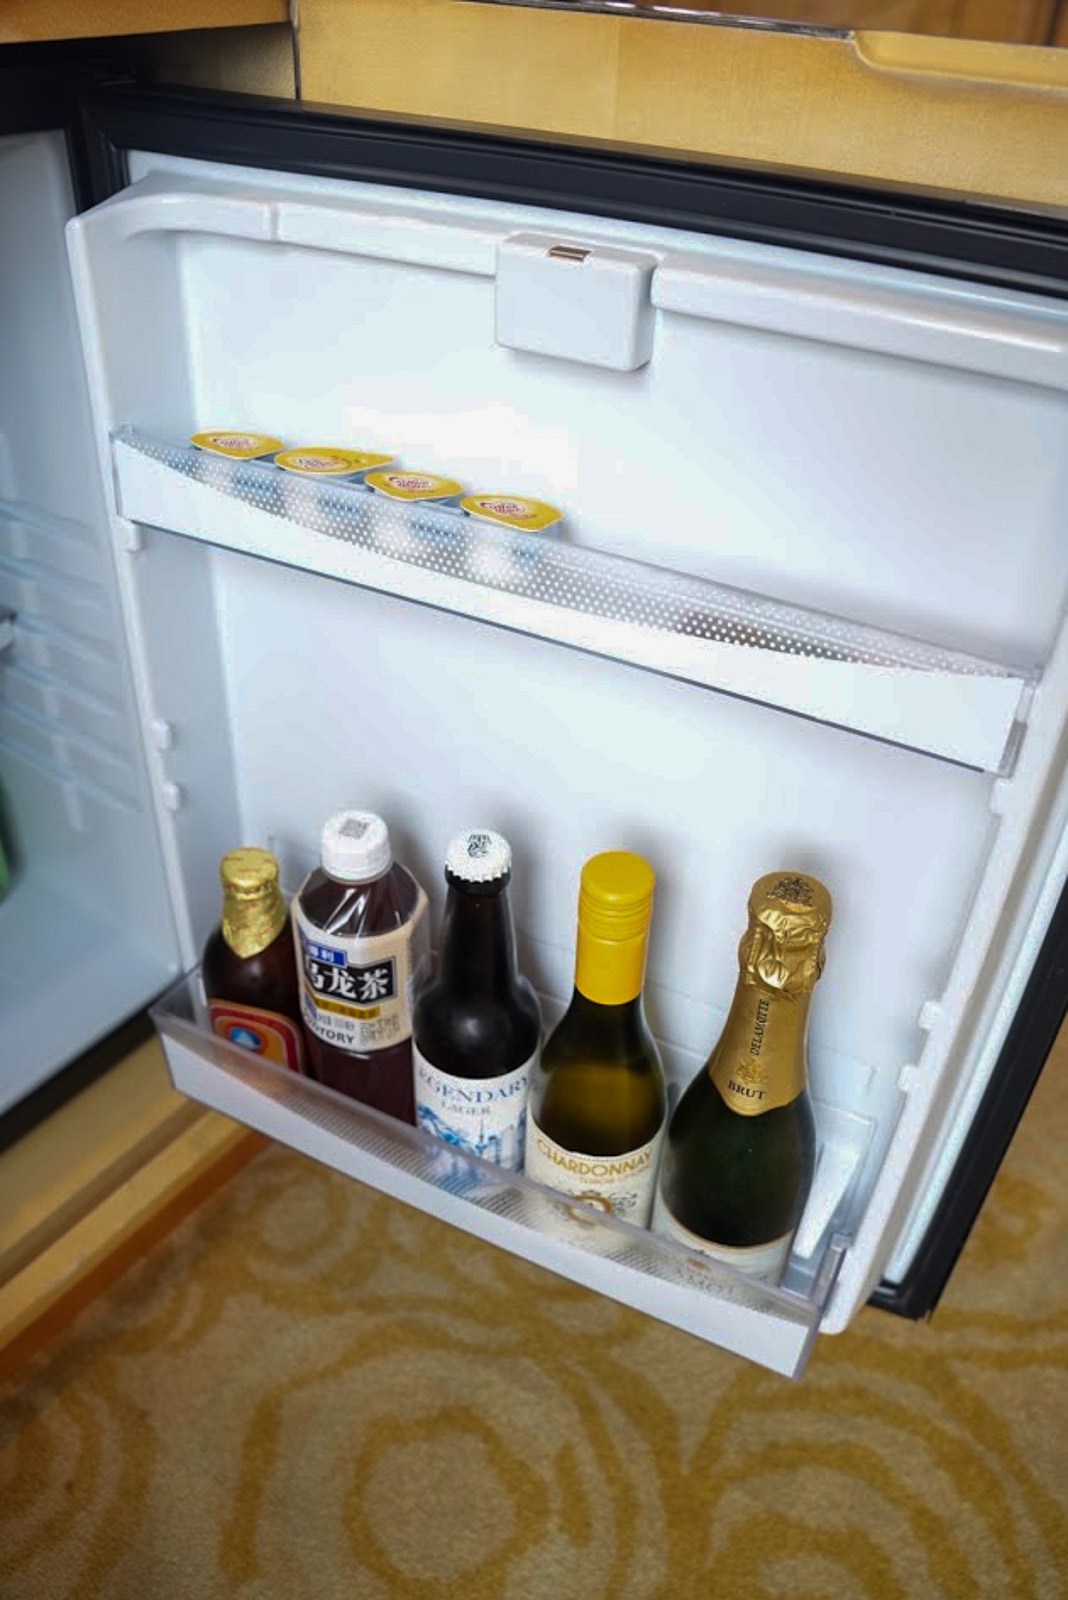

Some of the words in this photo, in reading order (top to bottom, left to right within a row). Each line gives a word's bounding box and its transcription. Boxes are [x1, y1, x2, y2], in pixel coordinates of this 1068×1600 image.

[308, 1016, 355, 1045] TORY
[749, 998, 770, 1056] DELAMOTTE
[727, 1079, 767, 1100] BRUT
[536, 1138, 651, 1177] CHARDONNAY
